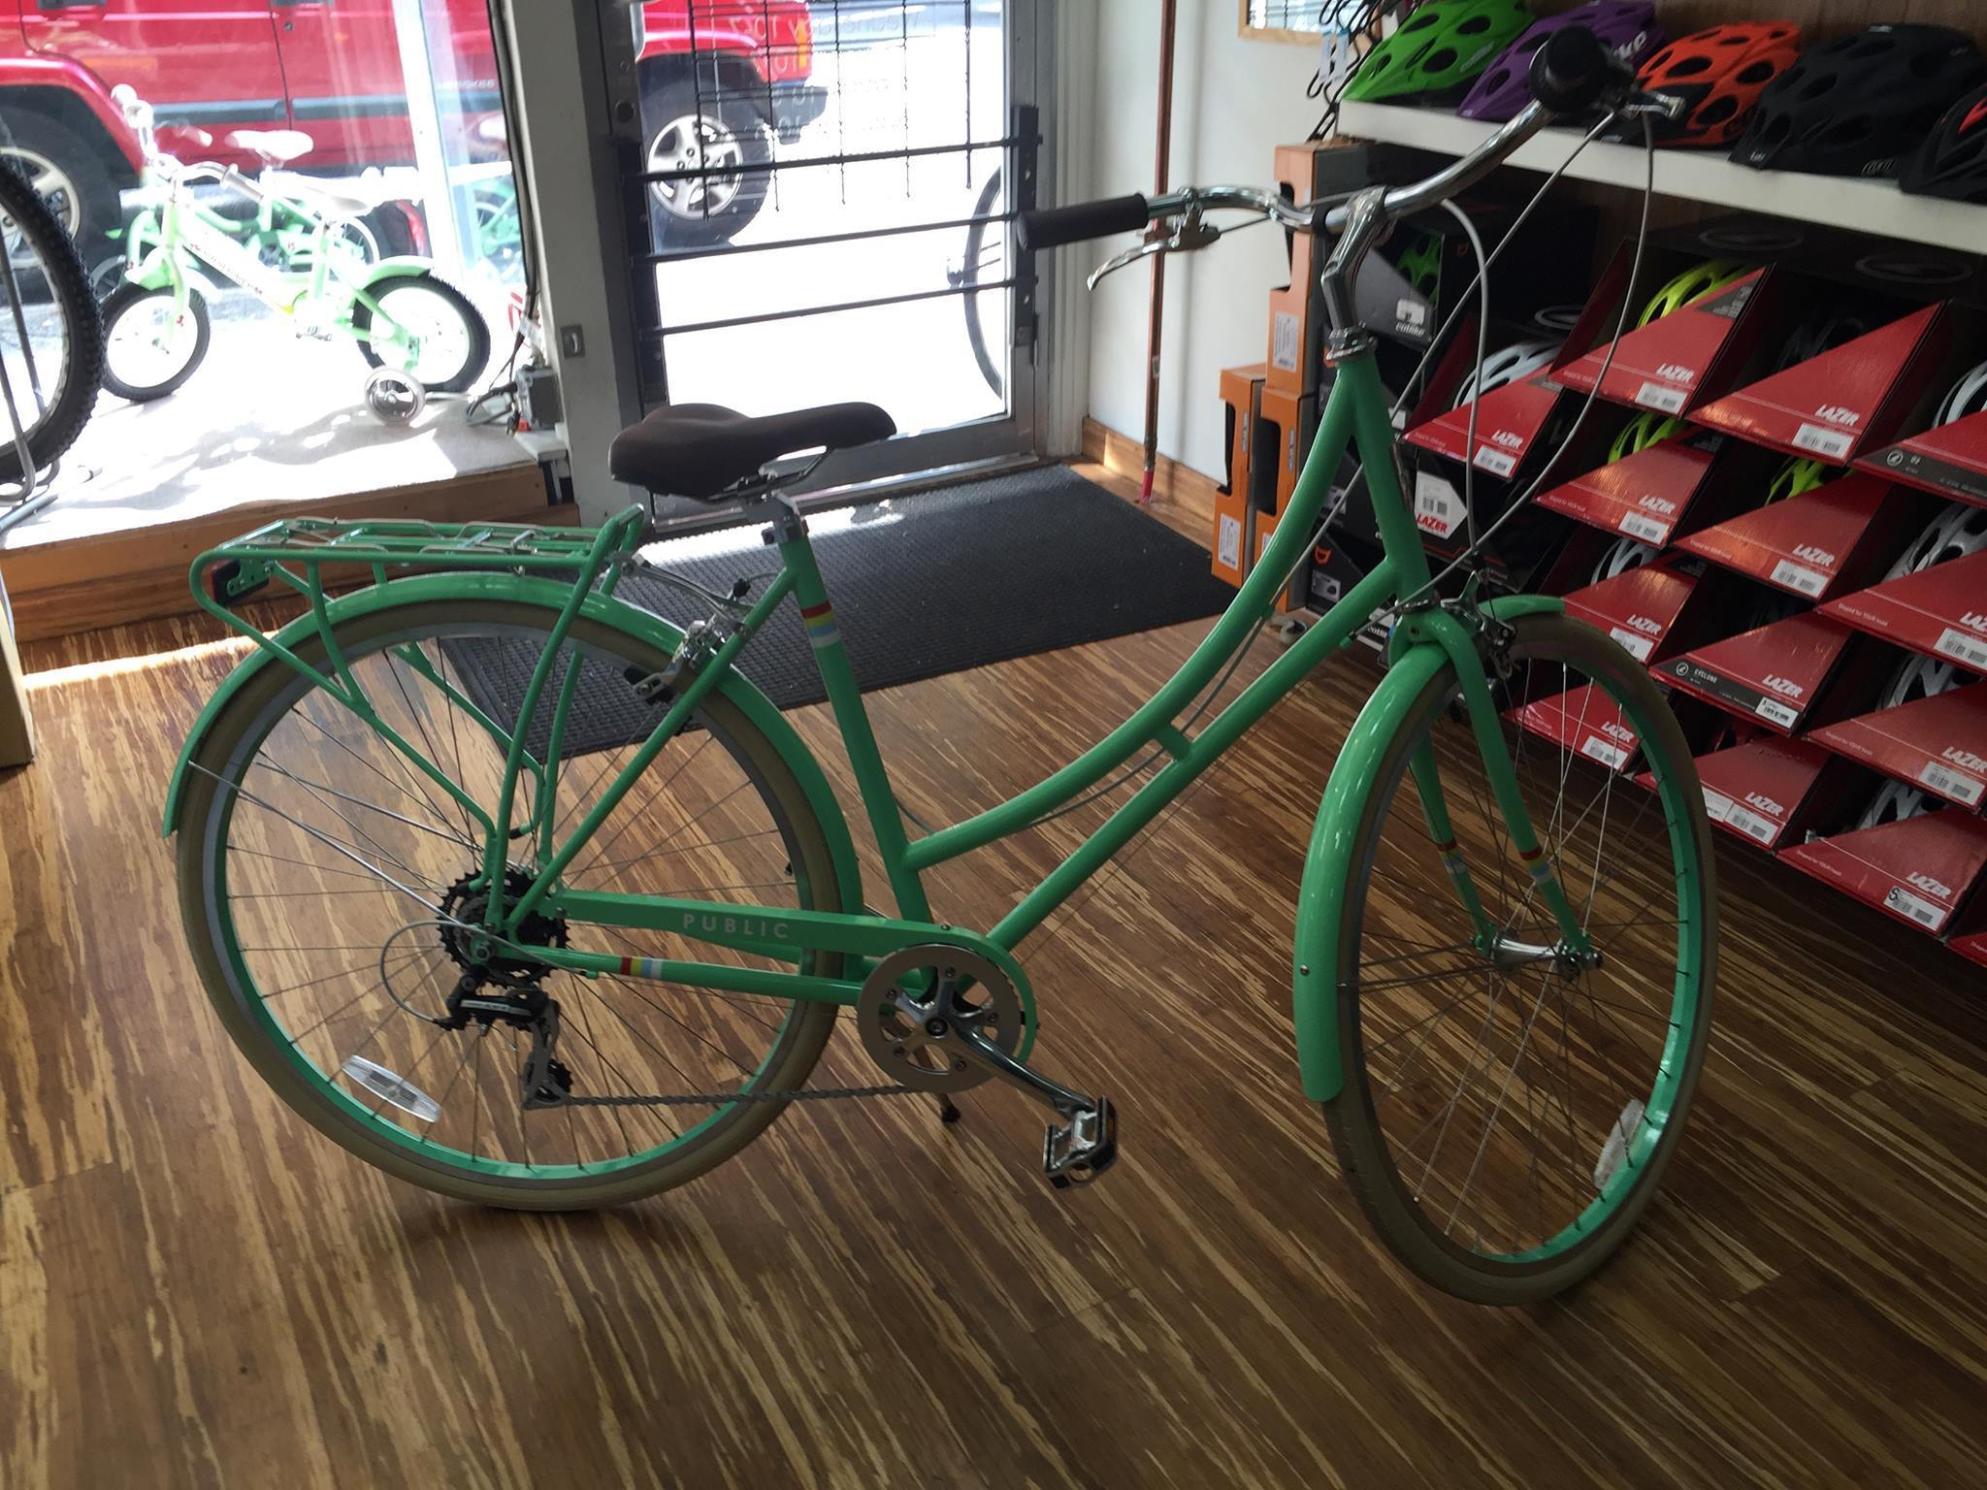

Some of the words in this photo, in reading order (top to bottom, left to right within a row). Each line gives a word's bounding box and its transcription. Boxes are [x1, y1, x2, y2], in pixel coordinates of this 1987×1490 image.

[1656, 363, 1694, 383] LAZER
[1815, 404, 1860, 426] LAZER
[1491, 429, 1523, 449] LAZER
[1638, 494, 1676, 514] LAZER
[1417, 513, 1448, 534] LAZER
[1792, 543, 1835, 567] LAZER
[1626, 614, 1662, 635] LAZER
[1762, 674, 1803, 698] LAZER
[1601, 721, 1634, 743] LAZER
[1942, 746, 1987, 773] LAZER
[1745, 792, 1784, 816] LAZER
[1888, 887, 1900, 901] S
[1906, 872, 1951, 899] LAZER
[683, 913, 789, 938] PUBLIC
